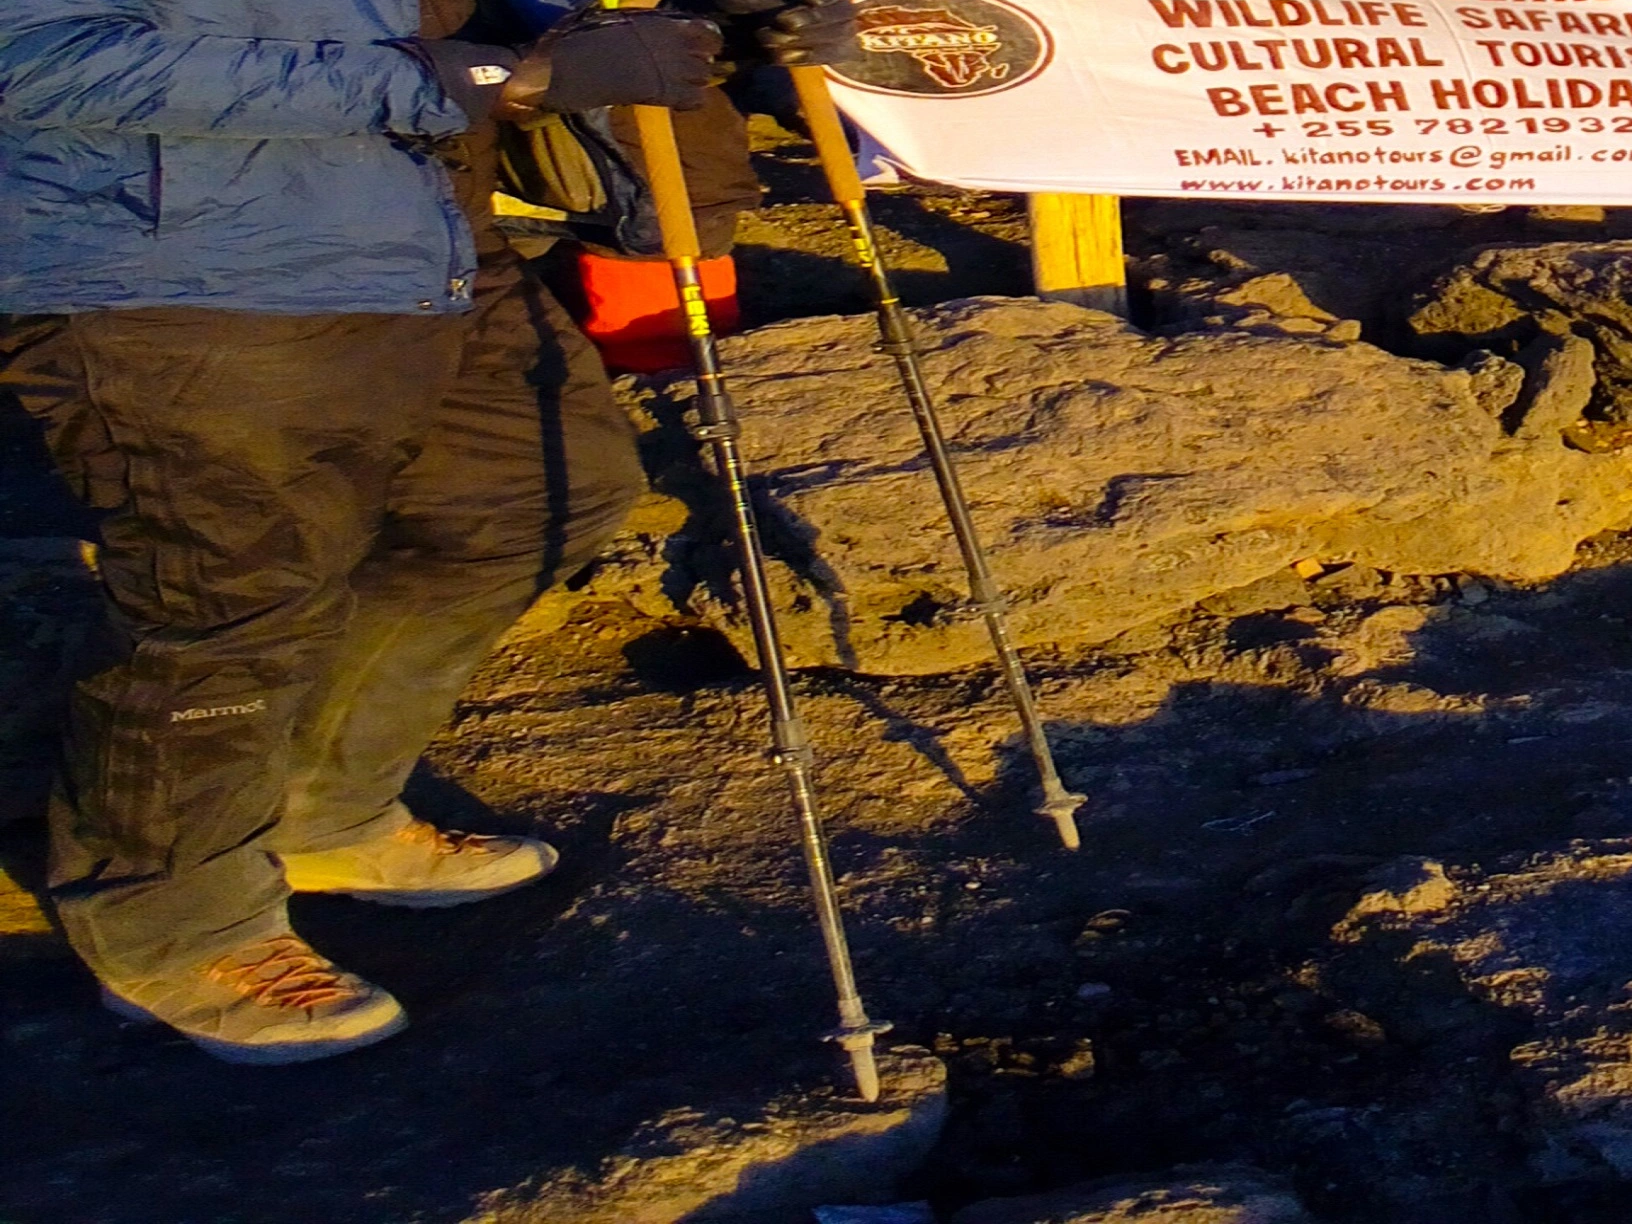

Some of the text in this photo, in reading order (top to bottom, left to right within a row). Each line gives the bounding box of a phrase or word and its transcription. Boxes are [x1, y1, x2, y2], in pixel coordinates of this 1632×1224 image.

[862, 32, 998, 48] KITANO
[1151, 36, 1443, 74] CULTURAL
[1208, 82, 1409, 117] BEACH
[1302, 119, 1394, 138] 255
[170, 699, 266, 722] Marmot
